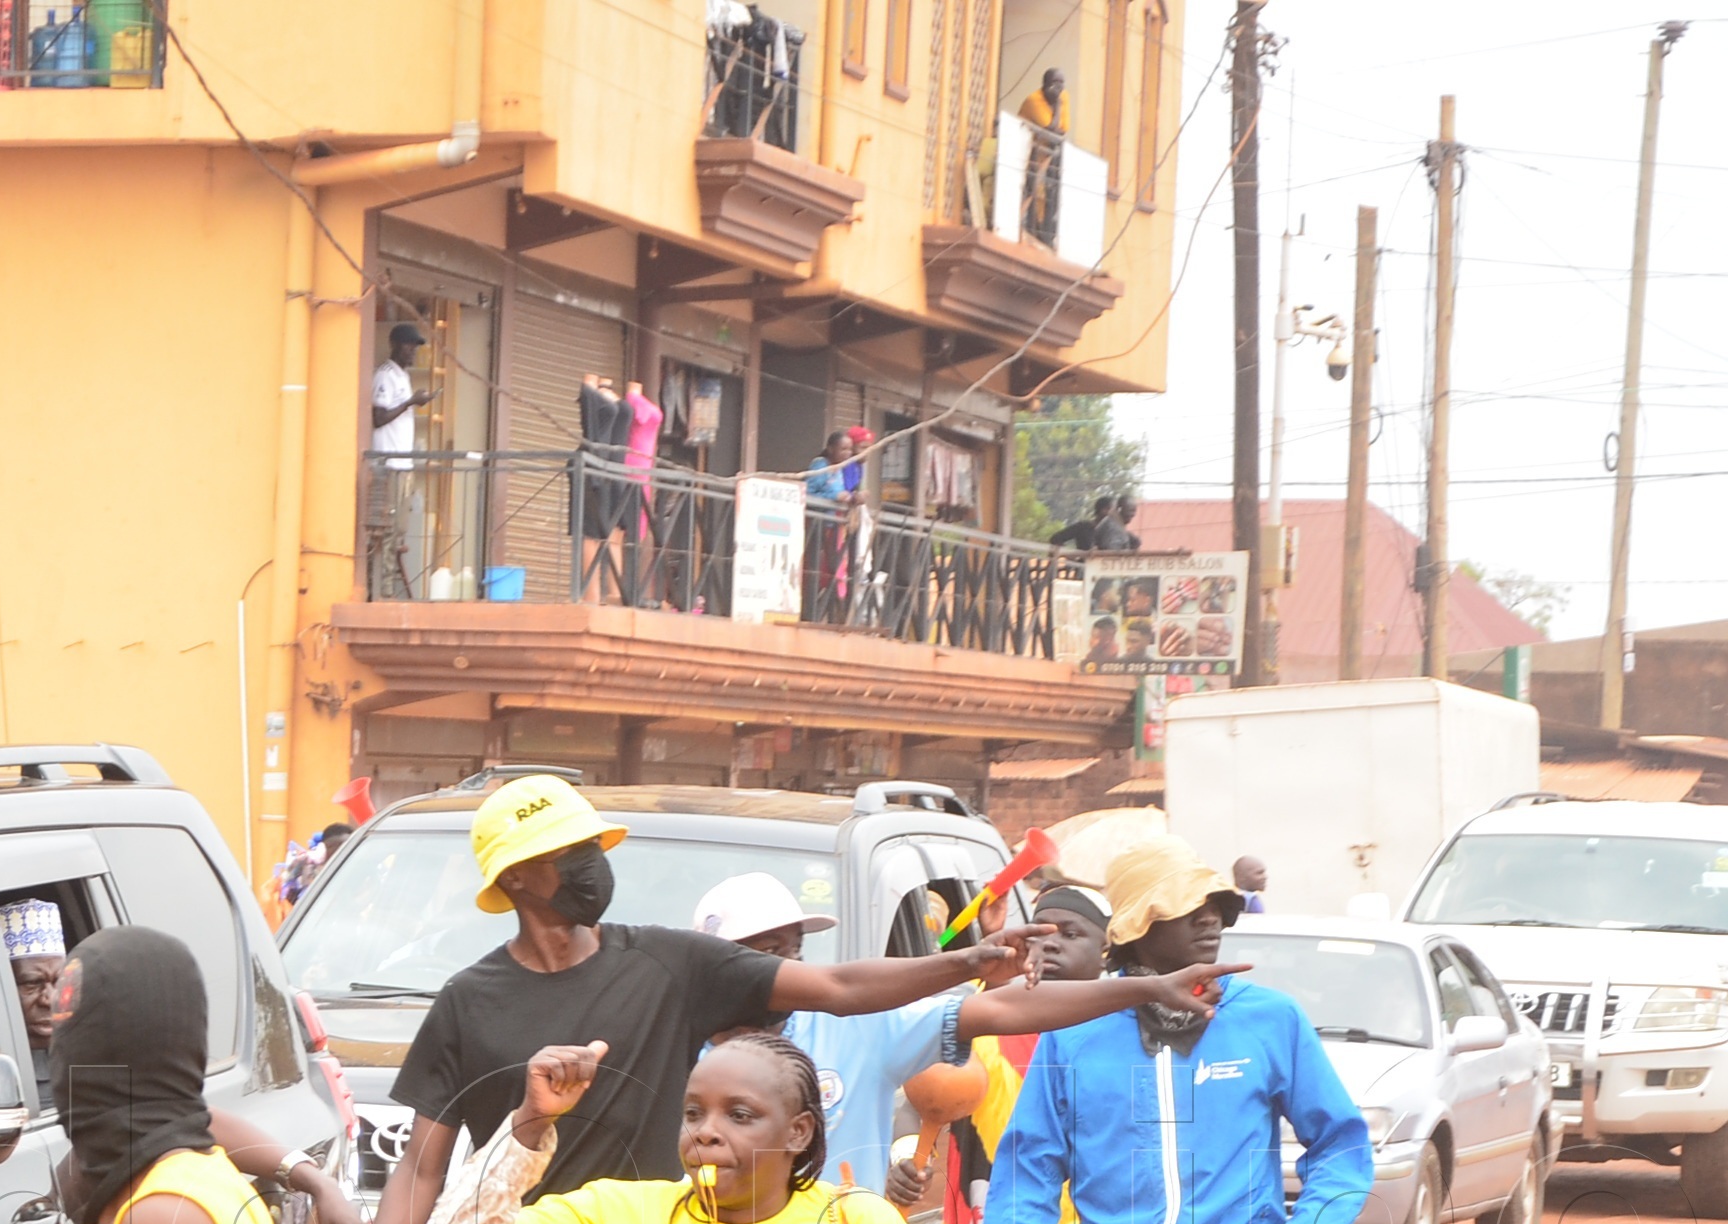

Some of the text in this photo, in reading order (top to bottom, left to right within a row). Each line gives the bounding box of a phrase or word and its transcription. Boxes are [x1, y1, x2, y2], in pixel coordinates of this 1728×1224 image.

[1100, 556, 1225, 571] STYLE HUB SALON
[515, 797, 553, 822] RAA
